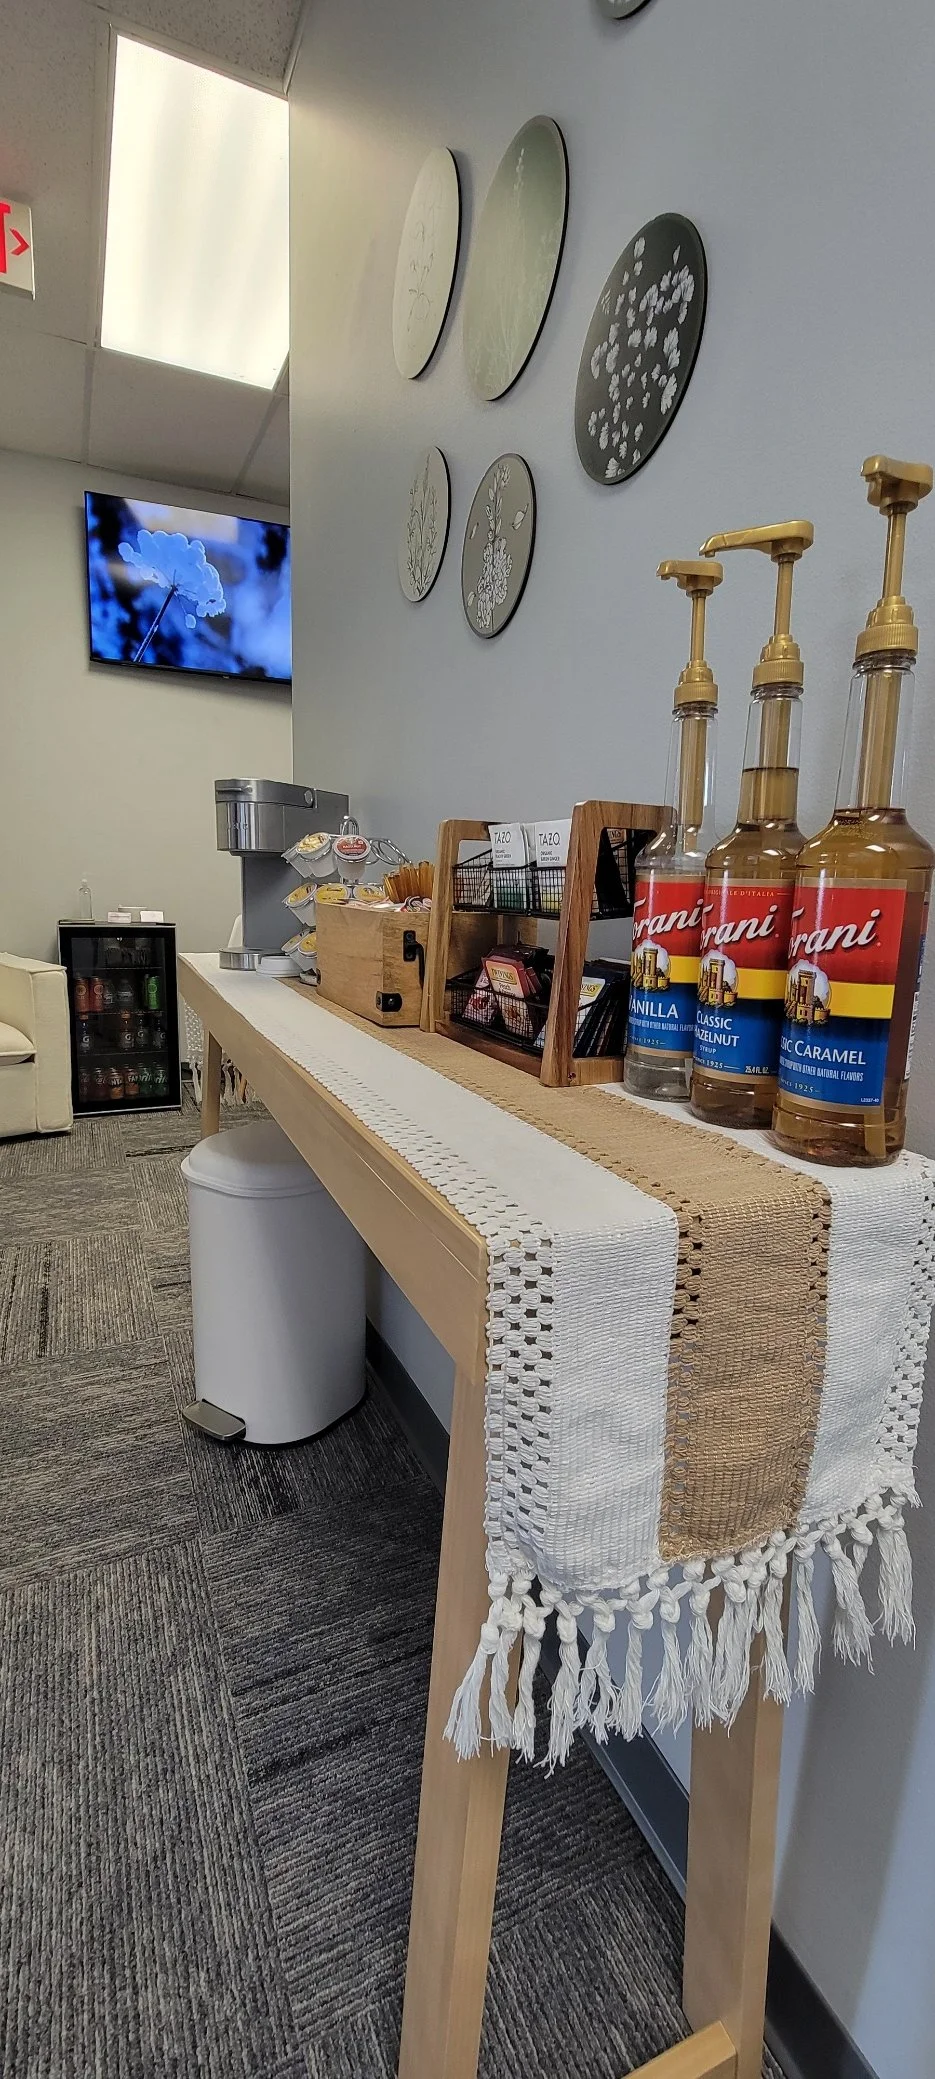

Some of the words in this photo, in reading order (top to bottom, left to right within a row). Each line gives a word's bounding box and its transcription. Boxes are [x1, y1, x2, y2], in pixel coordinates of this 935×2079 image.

[494, 831, 511, 844] TAZO
[538, 832, 560, 846] TAZO
[696, 1010, 733, 1030] CLASSIC
[661, 1022, 679, 1032] NATURAL
[700, 1044, 717, 1054] SYRUP
[794, 1040, 867, 1065] CARAMEL
[706, 1059, 724, 1069] 1925
[816, 1067, 840, 1080] NATURAL
[840, 1070, 864, 1082] FLAVORS
[794, 1082, 814, 1093] 1925
